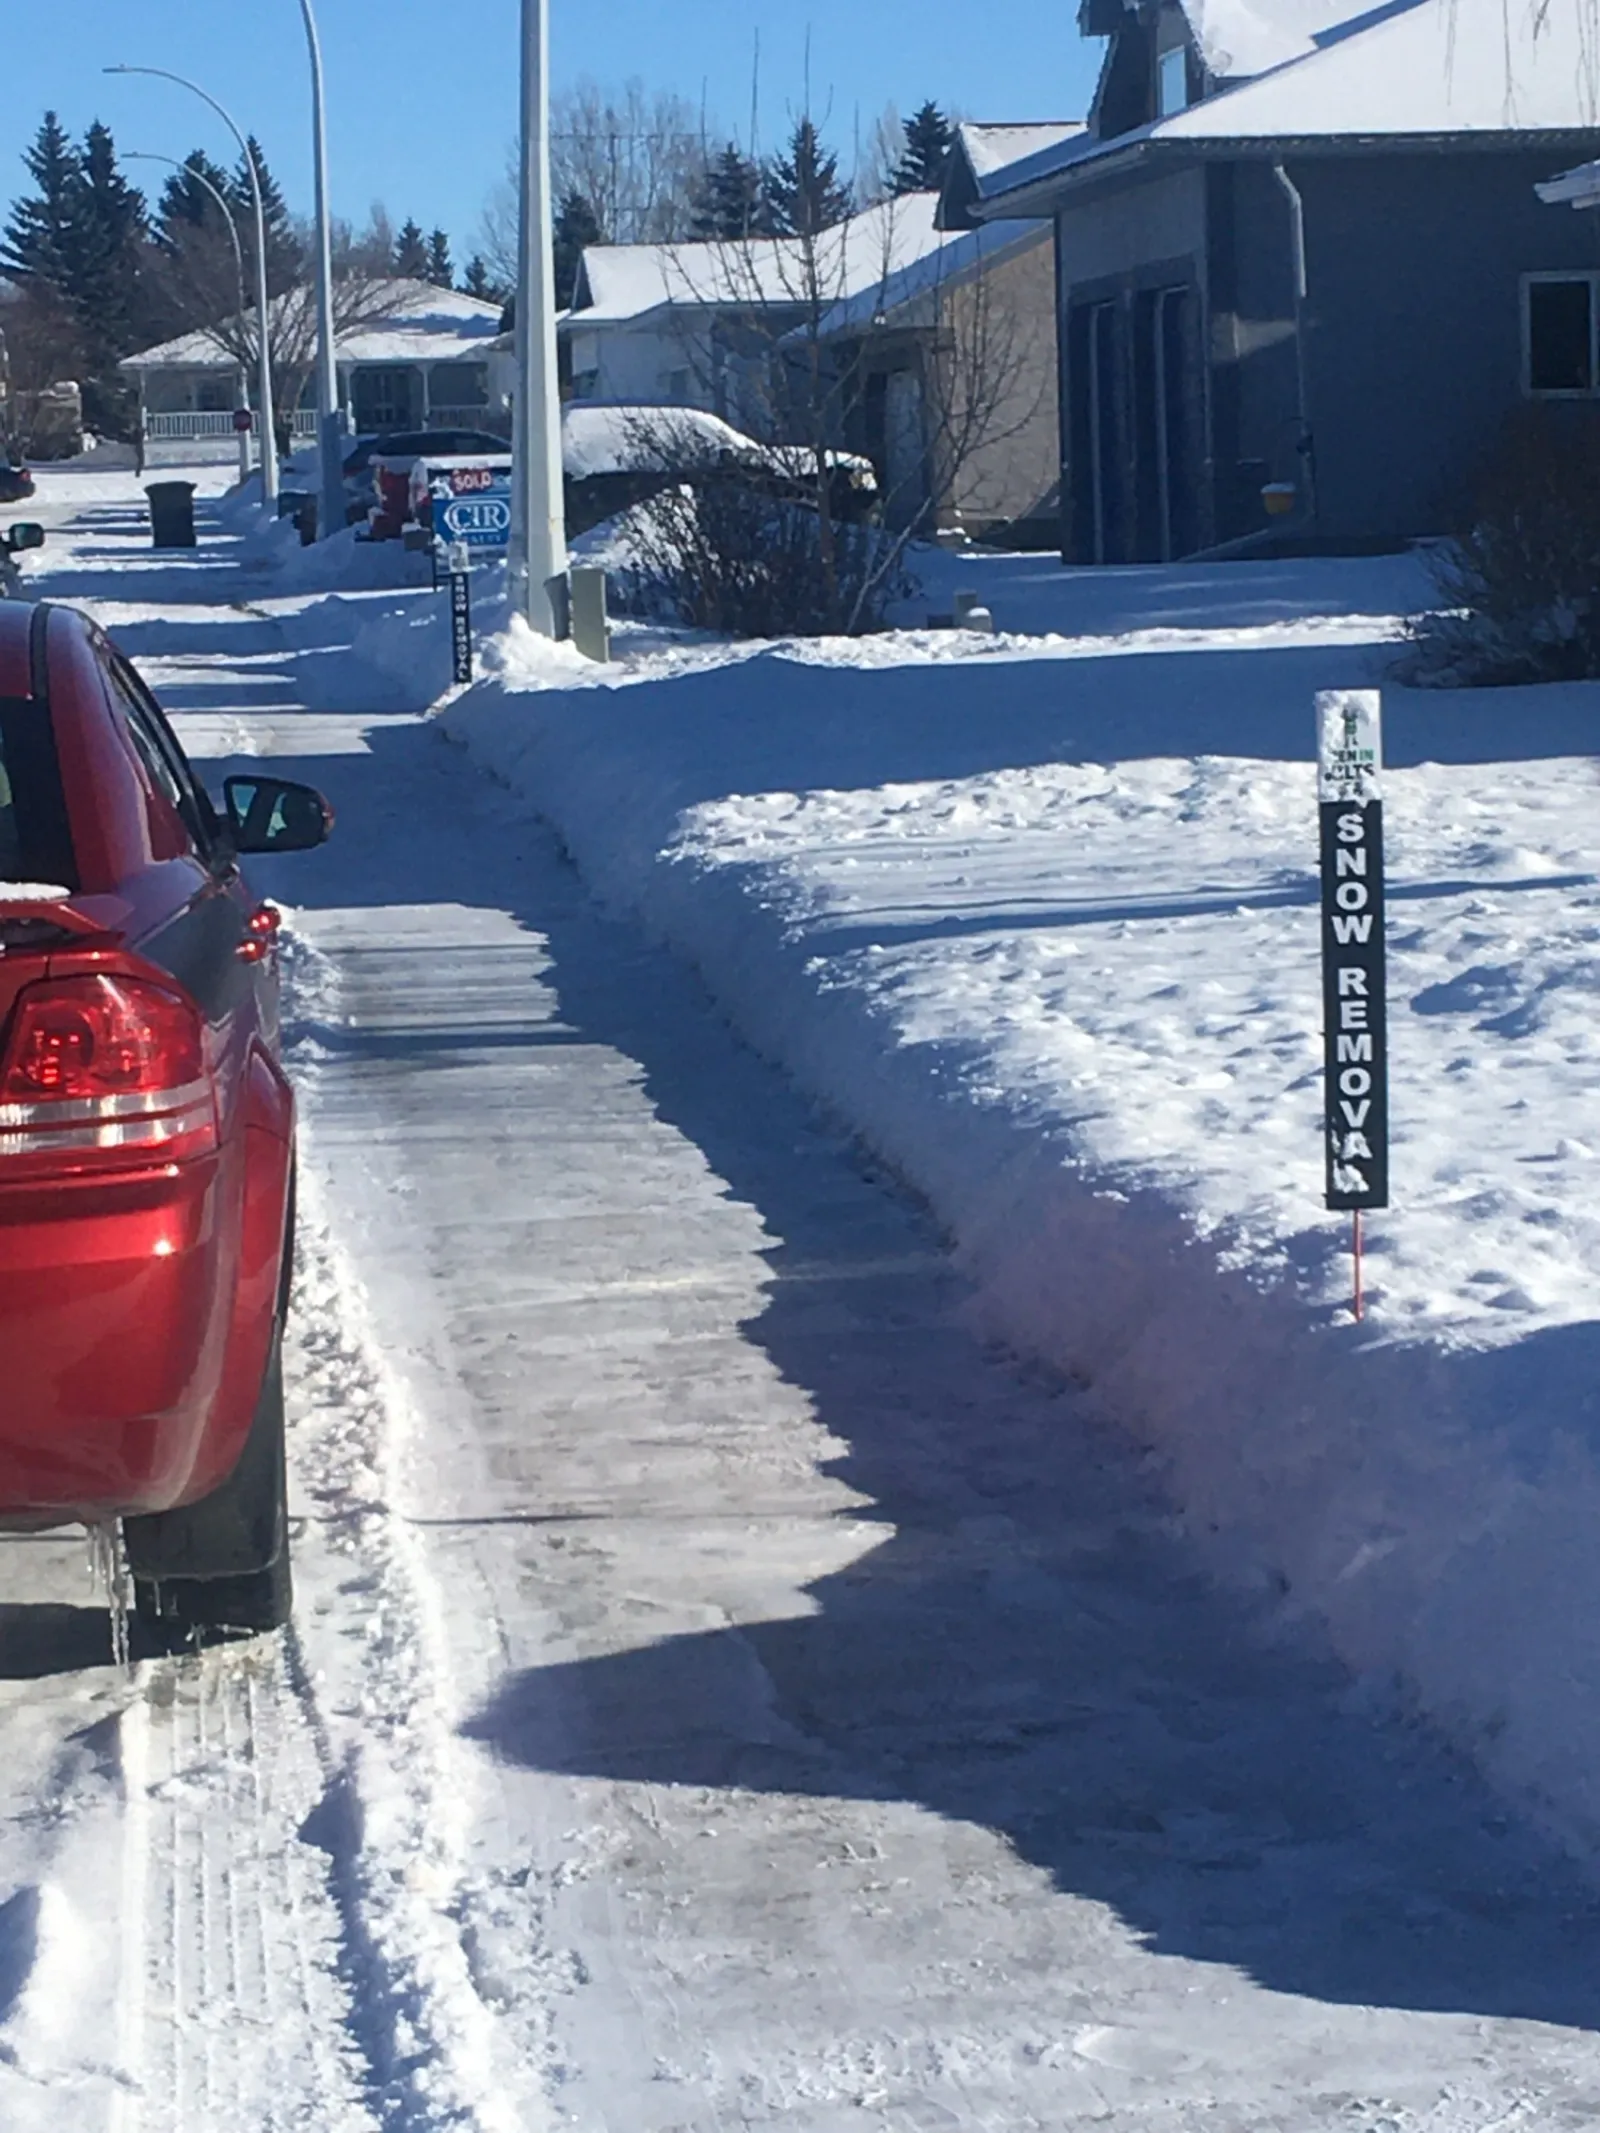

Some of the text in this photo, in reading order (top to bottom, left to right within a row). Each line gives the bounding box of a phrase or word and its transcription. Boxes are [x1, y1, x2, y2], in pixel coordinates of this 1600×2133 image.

[453, 471, 492, 491] SOLD
[452, 505, 501, 527] CIR
[455, 575, 468, 679] SNOW REMOVAL
[1359, 748, 1374, 760] IN
[1331, 813, 1373, 944] SNOW
